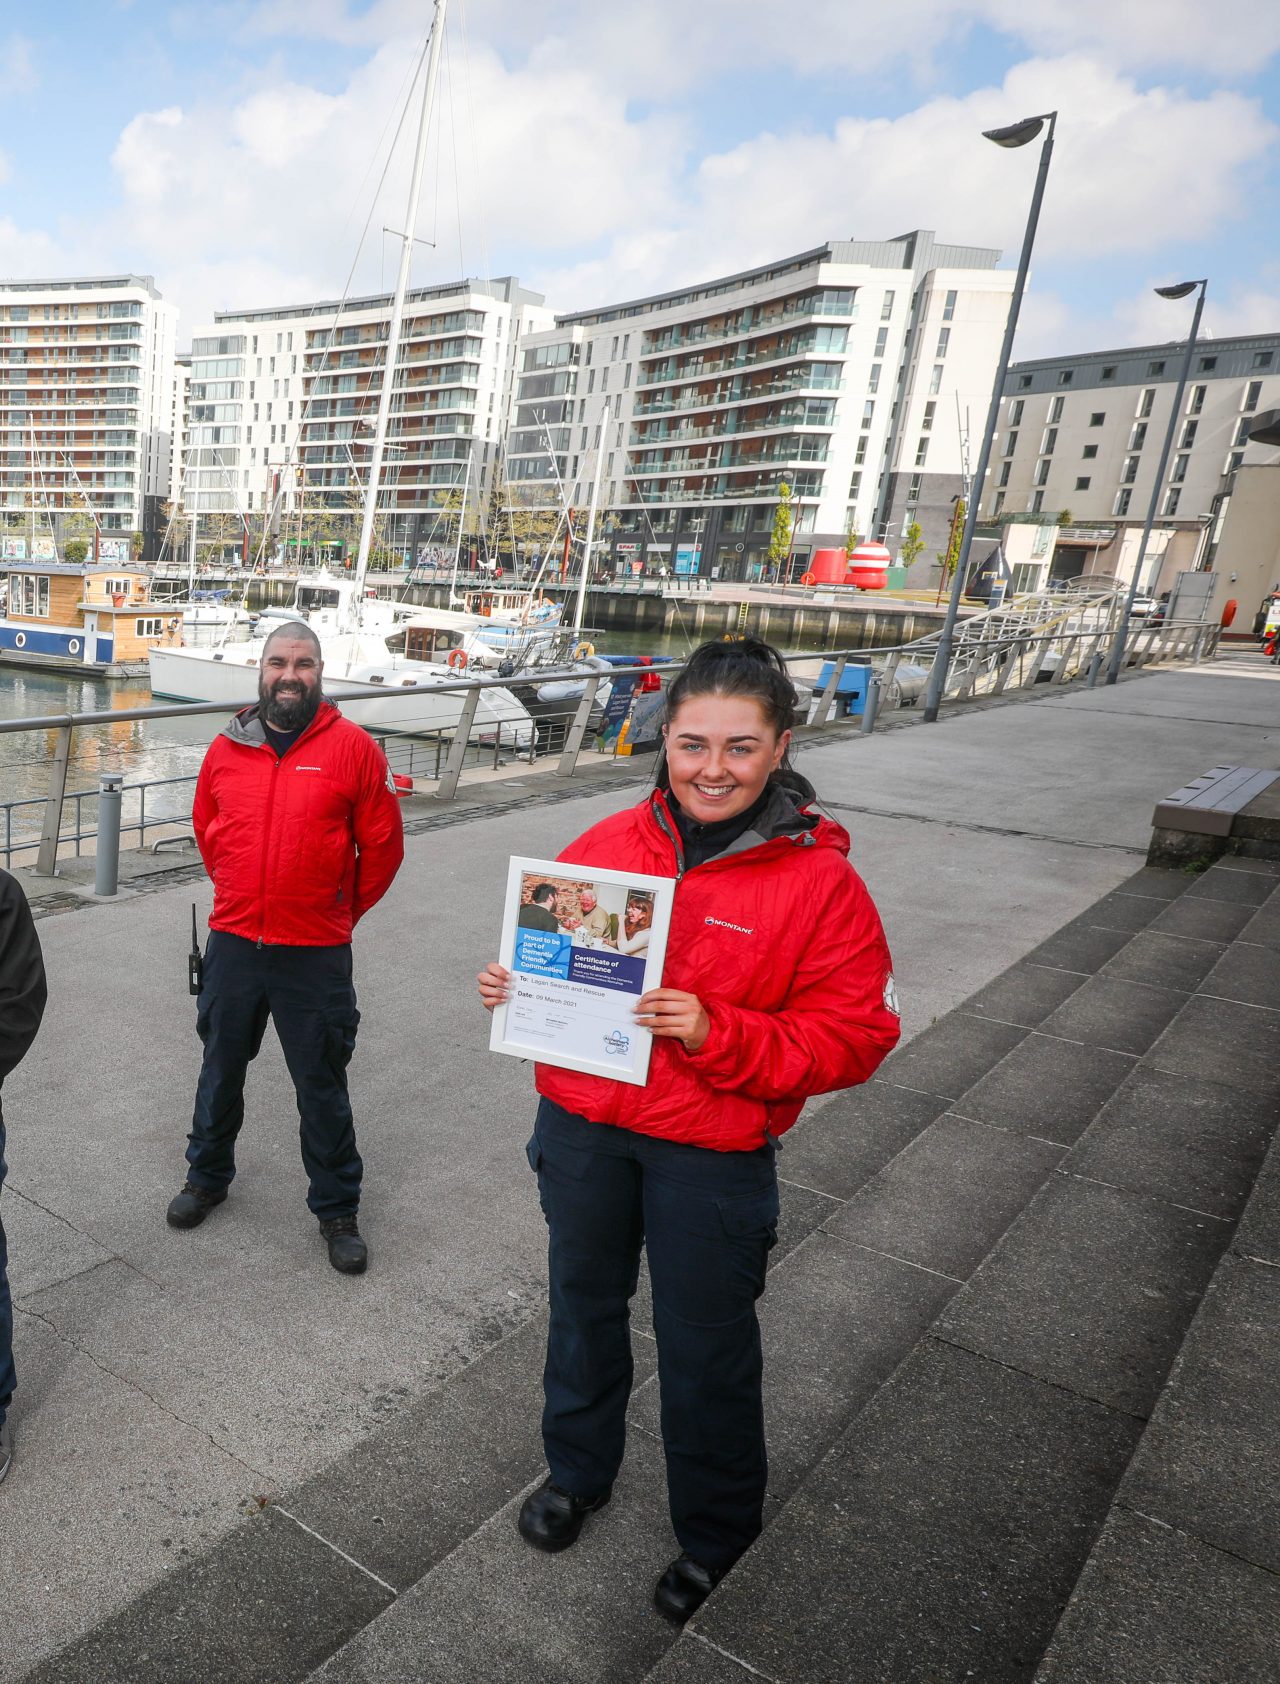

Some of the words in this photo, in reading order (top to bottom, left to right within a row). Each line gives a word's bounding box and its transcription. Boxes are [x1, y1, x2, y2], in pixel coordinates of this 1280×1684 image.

[714, 919, 754, 935] MONTANE
[524, 933, 543, 942] Proud
[522, 948, 553, 958] Dementia
[521, 954, 547, 965] Friendly
[575, 954, 610, 966] Certificate
[520, 961, 563, 974] Communities
[574, 962, 612, 973] attendance
[531, 978, 549, 986] Lagan
[550, 981, 570, 990] Search
[583, 988, 605, 998] Rescue
[517, 990, 533, 998] Date:
[544, 996, 562, 1004] March
